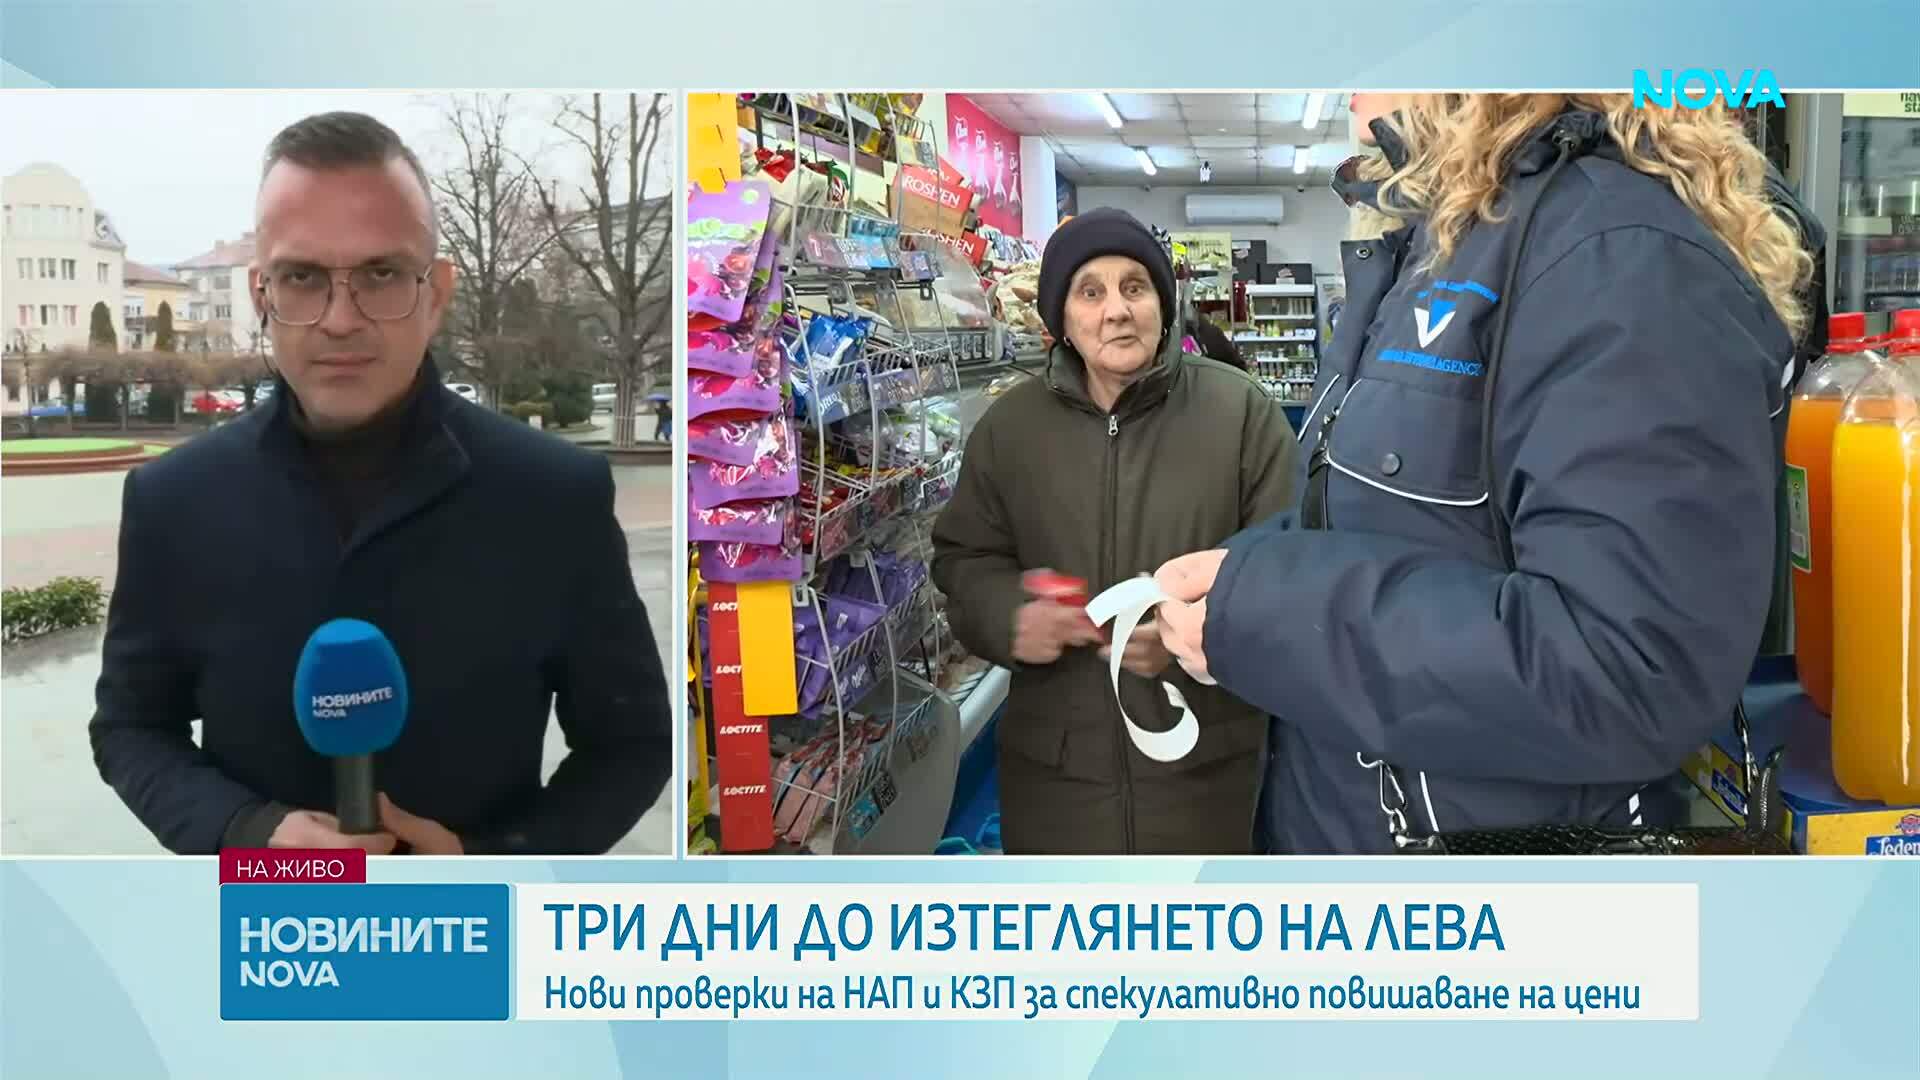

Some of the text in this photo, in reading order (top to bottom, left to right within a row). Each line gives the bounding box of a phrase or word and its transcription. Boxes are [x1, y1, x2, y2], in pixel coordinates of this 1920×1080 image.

[902, 175, 961, 208] ROSHEN
[312, 686, 393, 708] НОВИНИТЕ
[312, 708, 347, 718] NOVA
[720, 724, 763, 735] LOCTITE
[724, 784, 767, 796] LOCTITE
